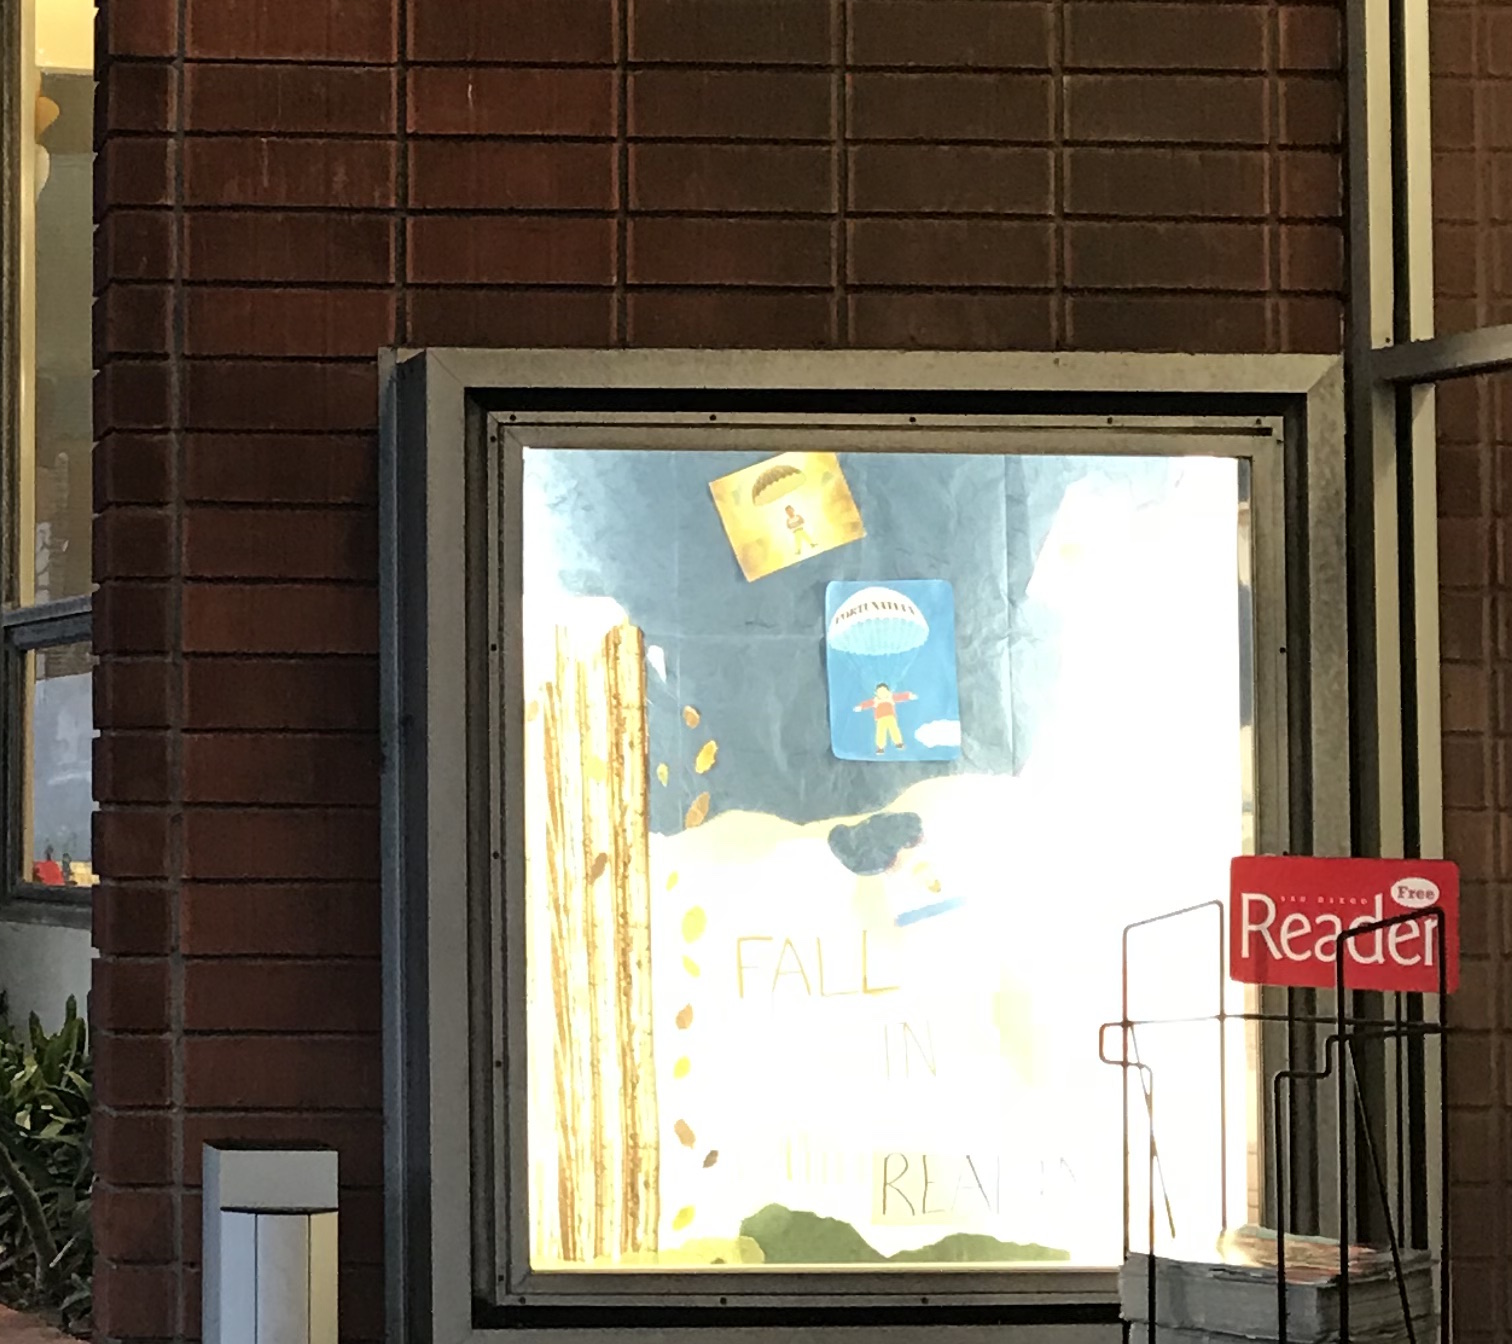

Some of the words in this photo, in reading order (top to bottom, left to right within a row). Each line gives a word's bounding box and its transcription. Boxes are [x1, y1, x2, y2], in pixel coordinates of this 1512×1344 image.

[1397, 885, 1435, 901] Free
[1240, 892, 1439, 967] Reader
[736, 929, 901, 999] FALL
[884, 1018, 938, 1079] IN
